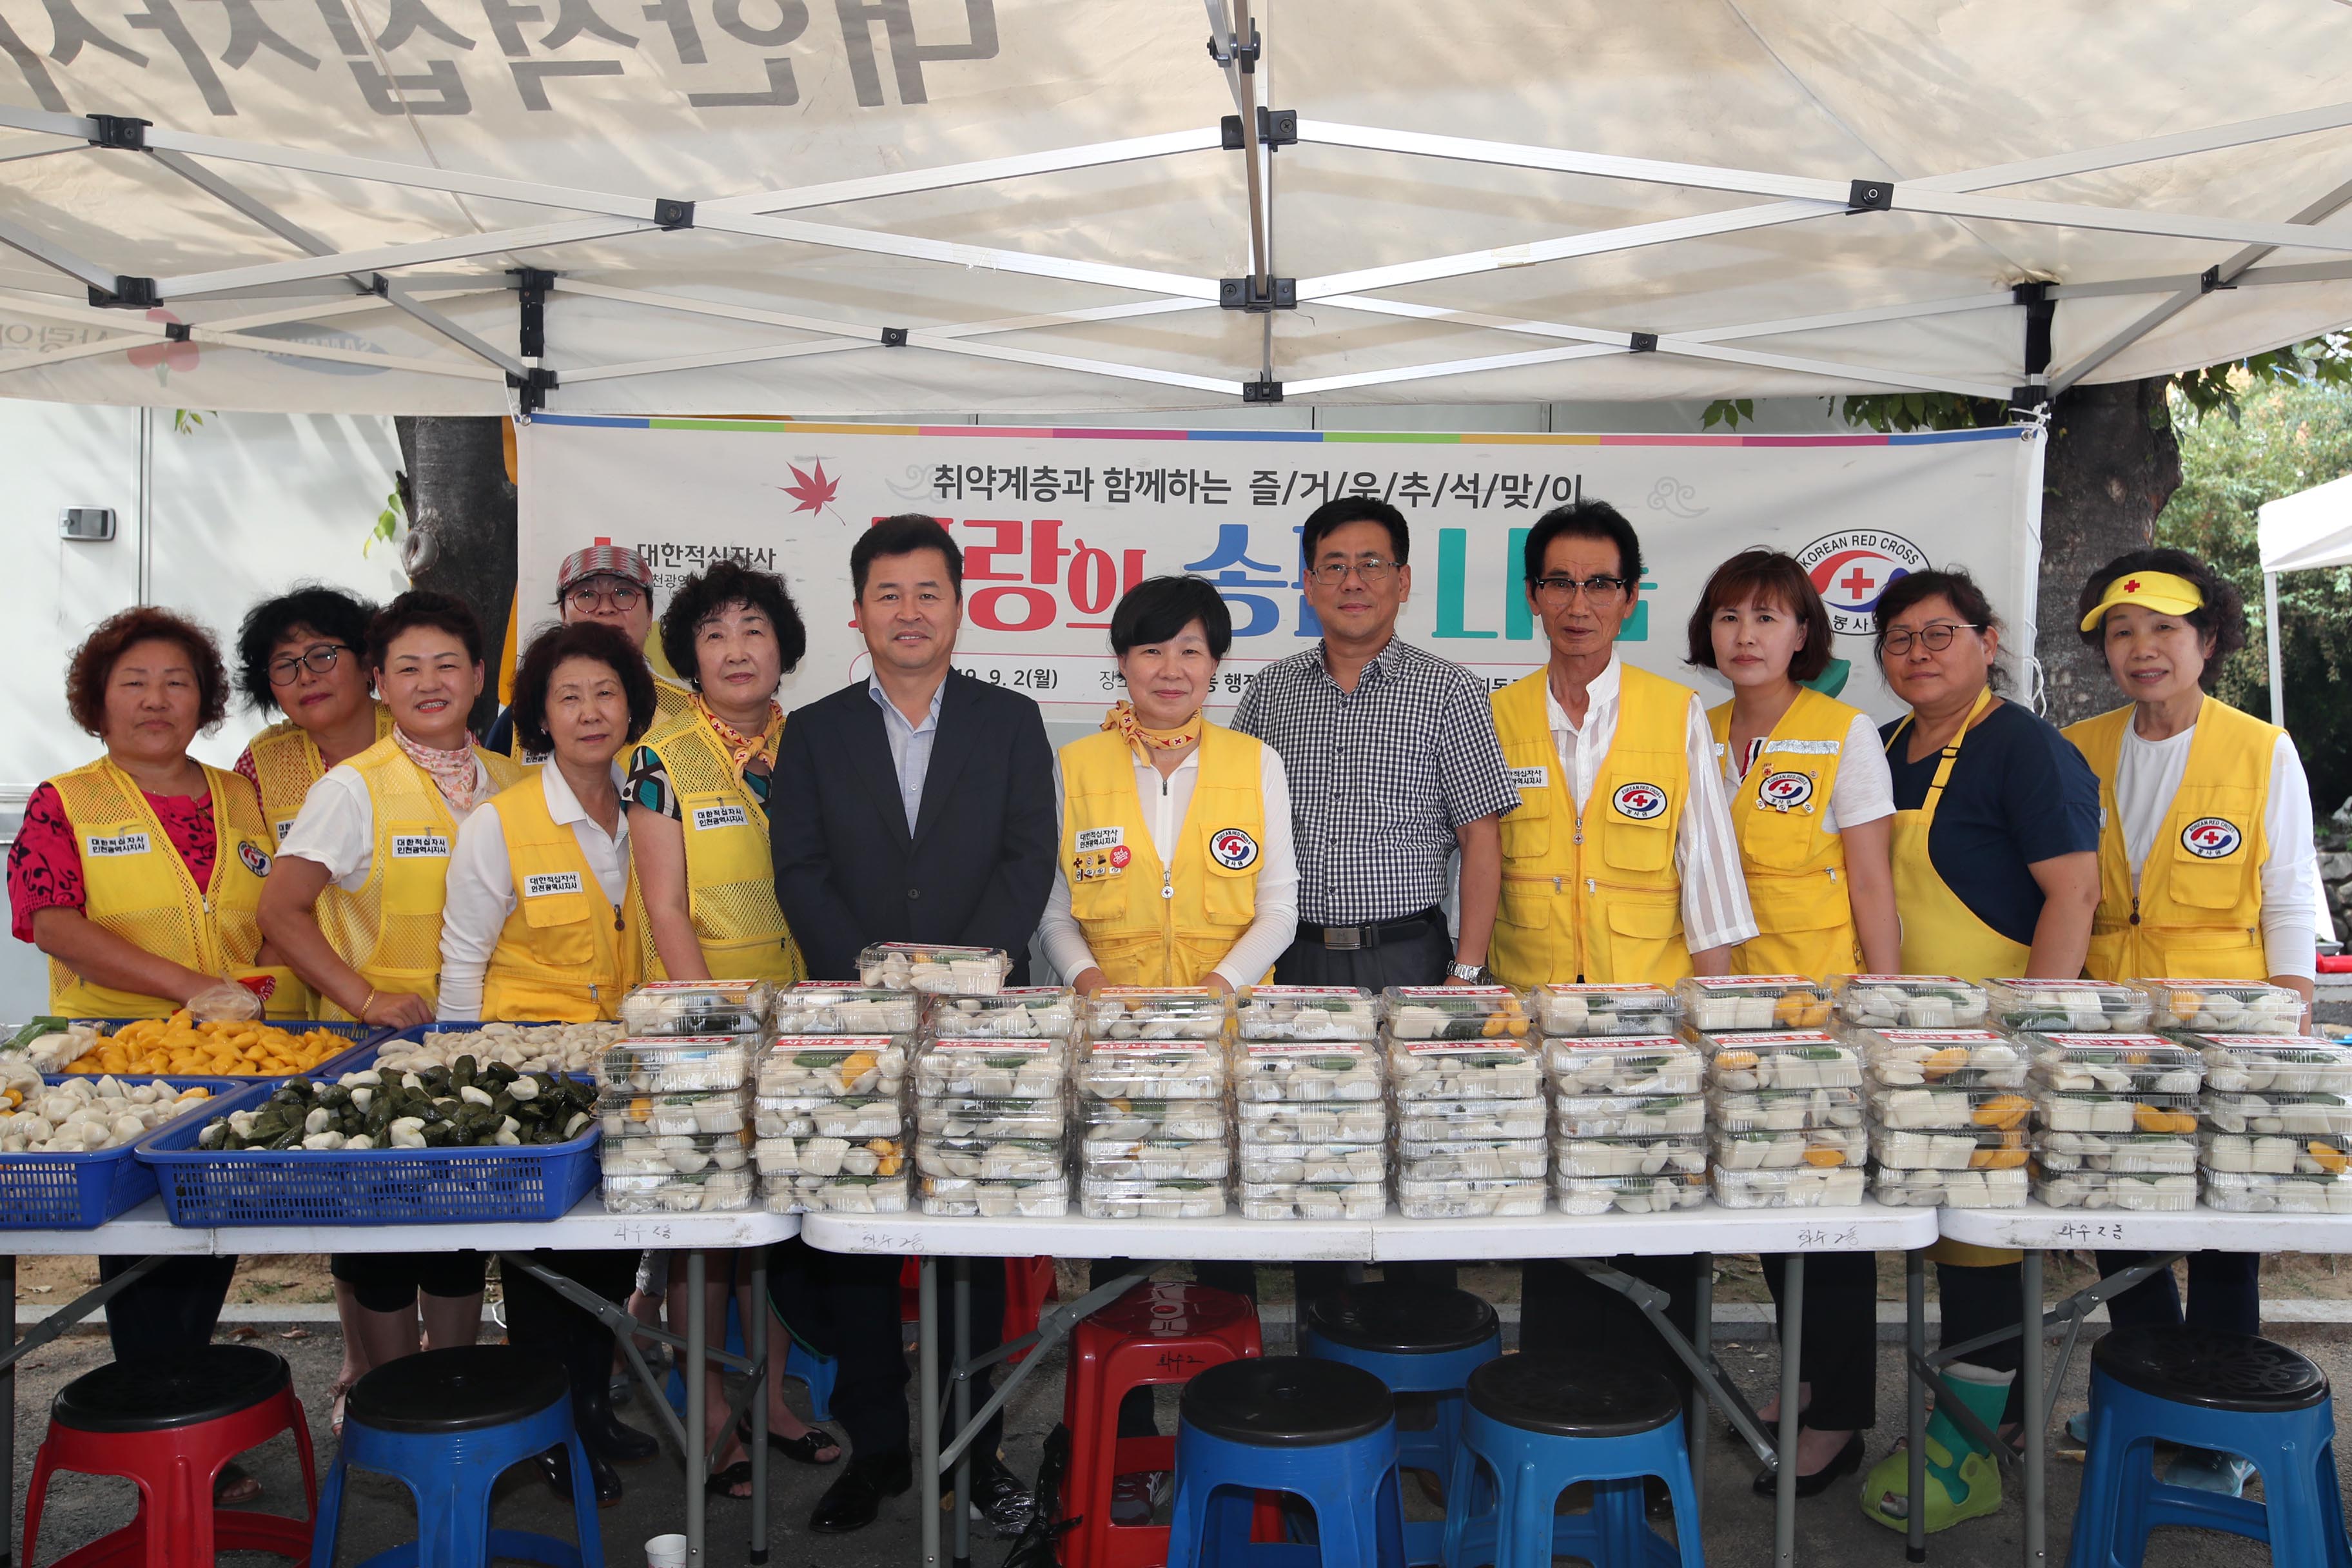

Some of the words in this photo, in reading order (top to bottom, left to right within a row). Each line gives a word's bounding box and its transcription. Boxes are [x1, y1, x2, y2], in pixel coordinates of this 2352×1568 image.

[933, 464, 1095, 502] 취약계층과
[1102, 467, 1231, 504] 함께하는
[1799, 536, 1848, 569] KOREAN
[1852, 534, 1877, 547] RED
[1880, 538, 1919, 565] CROSS
[697, 808, 742, 819] 대한적십자사
[699, 815, 744, 827] 인천광역시지사
[1079, 828, 1119, 841] 대한적십자사
[397, 846, 446, 854] 인천광역시지사
[529, 874, 577, 885] 대한적십자사
